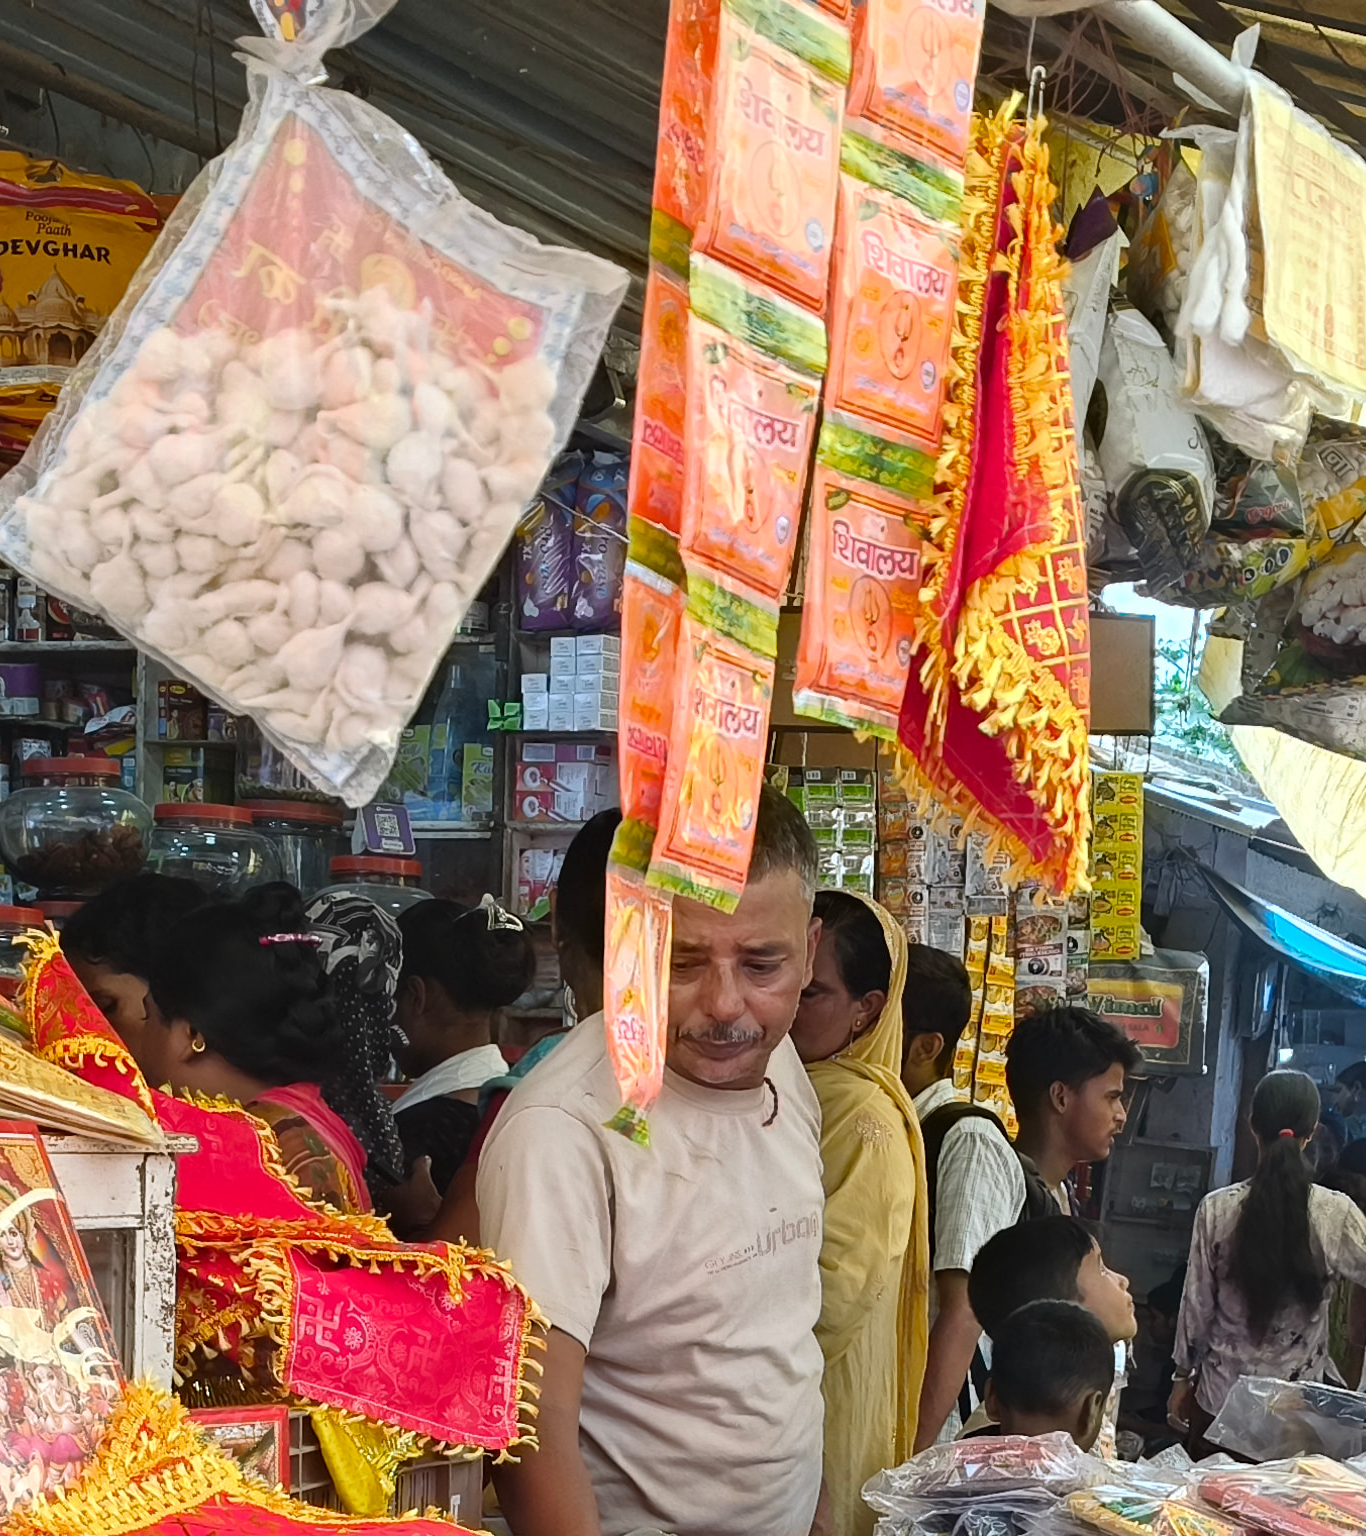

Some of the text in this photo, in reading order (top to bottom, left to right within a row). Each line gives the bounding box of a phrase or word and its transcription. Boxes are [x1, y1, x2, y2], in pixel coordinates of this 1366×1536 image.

[36, 223, 72, 237] Paath
[860, 229, 949, 297] शिवालय
[831, 521, 921, 577] शिवालय
[1087, 995, 1164, 1018] Vimal
